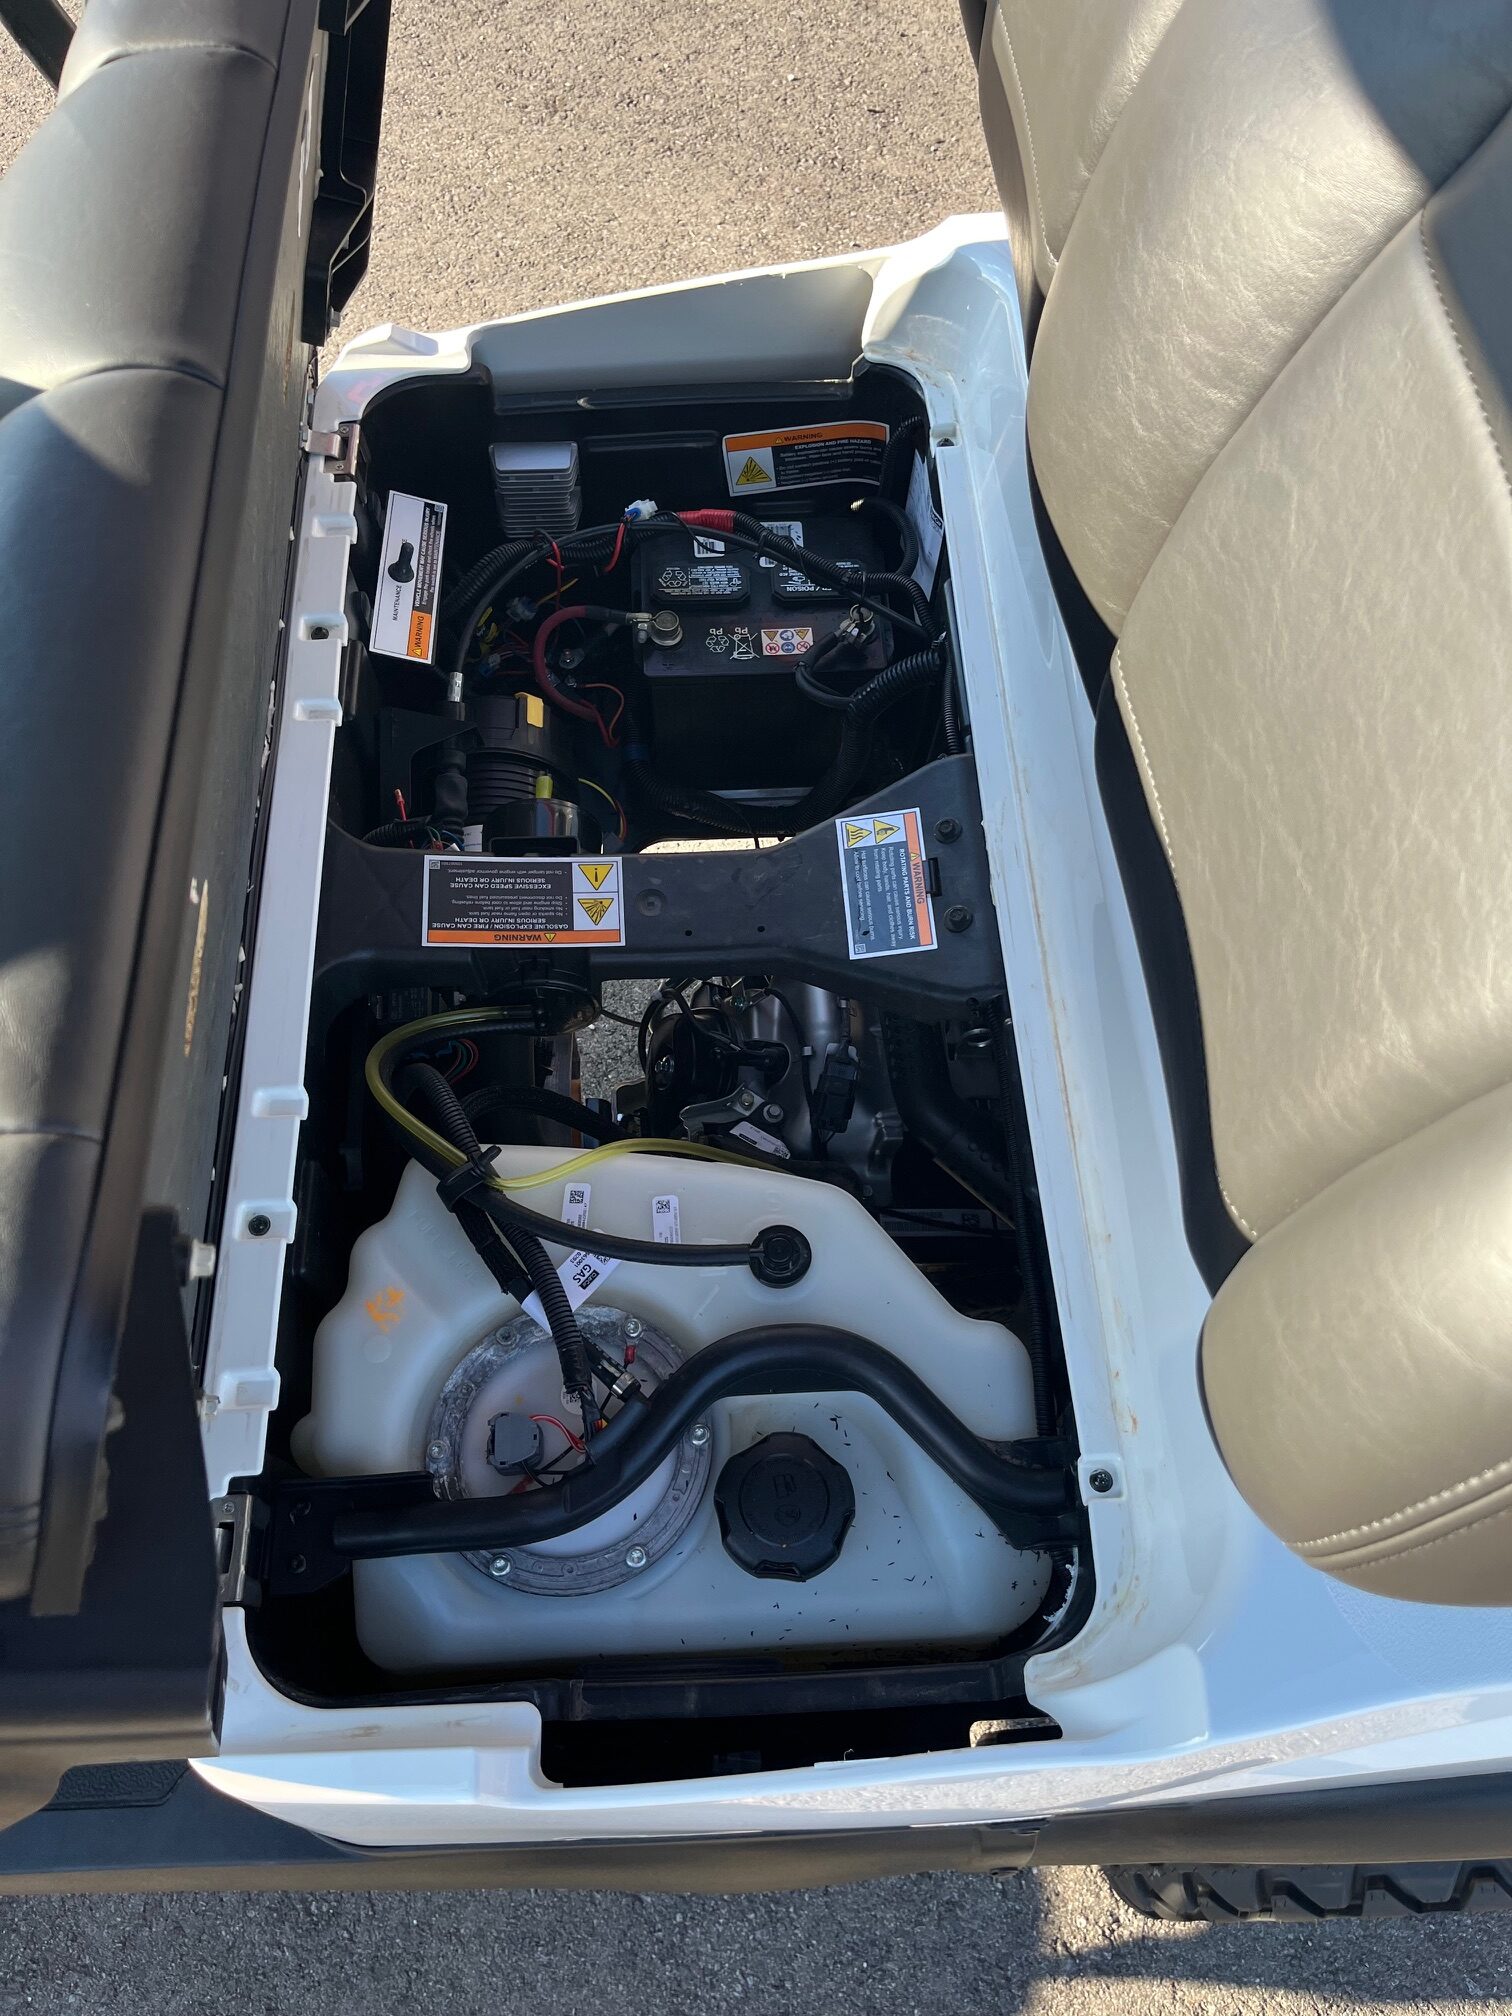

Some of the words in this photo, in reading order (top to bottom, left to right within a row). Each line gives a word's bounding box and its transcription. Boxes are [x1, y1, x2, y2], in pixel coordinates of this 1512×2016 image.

[784, 432, 822, 441] WARNING
[849, 436, 872, 446] HAZARD
[419, 539, 427, 555] CAUSE
[416, 563, 424, 588] MOVEMENT
[391, 584, 401, 621] MAINTENANCE
[413, 614, 424, 648] WARNING
[879, 847, 887, 860] Keep
[898, 848, 907, 875] ROTATING
[902, 876, 910, 895] PARTS
[912, 862, 924, 904] WARNING
[493, 933, 541, 941] WARNING
[572, 1264, 592, 1284] GAS
